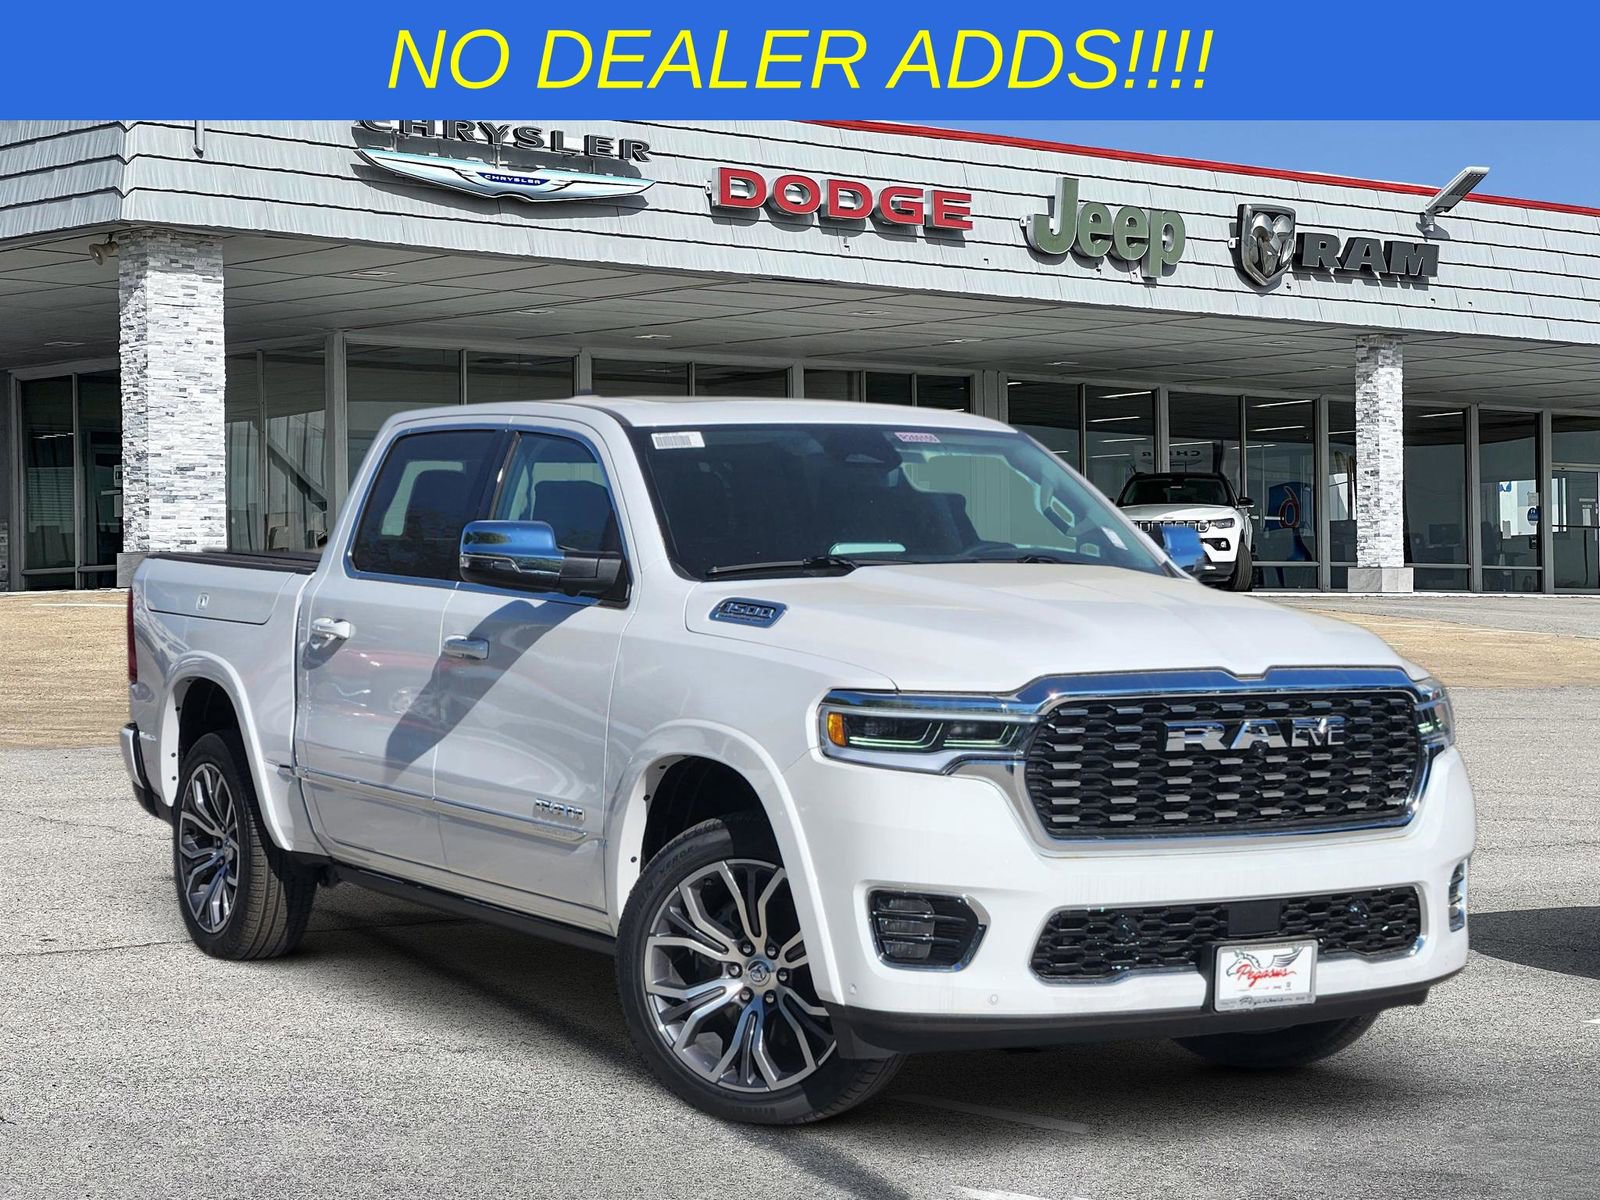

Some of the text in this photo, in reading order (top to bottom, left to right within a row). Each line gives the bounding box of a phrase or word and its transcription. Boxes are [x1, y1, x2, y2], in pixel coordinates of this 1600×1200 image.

[484, 174, 541, 185] CHRYSLER
[711, 166, 973, 230] DODGE
[1027, 177, 1186, 278] Jeep
[1297, 232, 1440, 277] RAM
[727, 602, 775, 618] 1500
[1165, 715, 1346, 752] RAM
